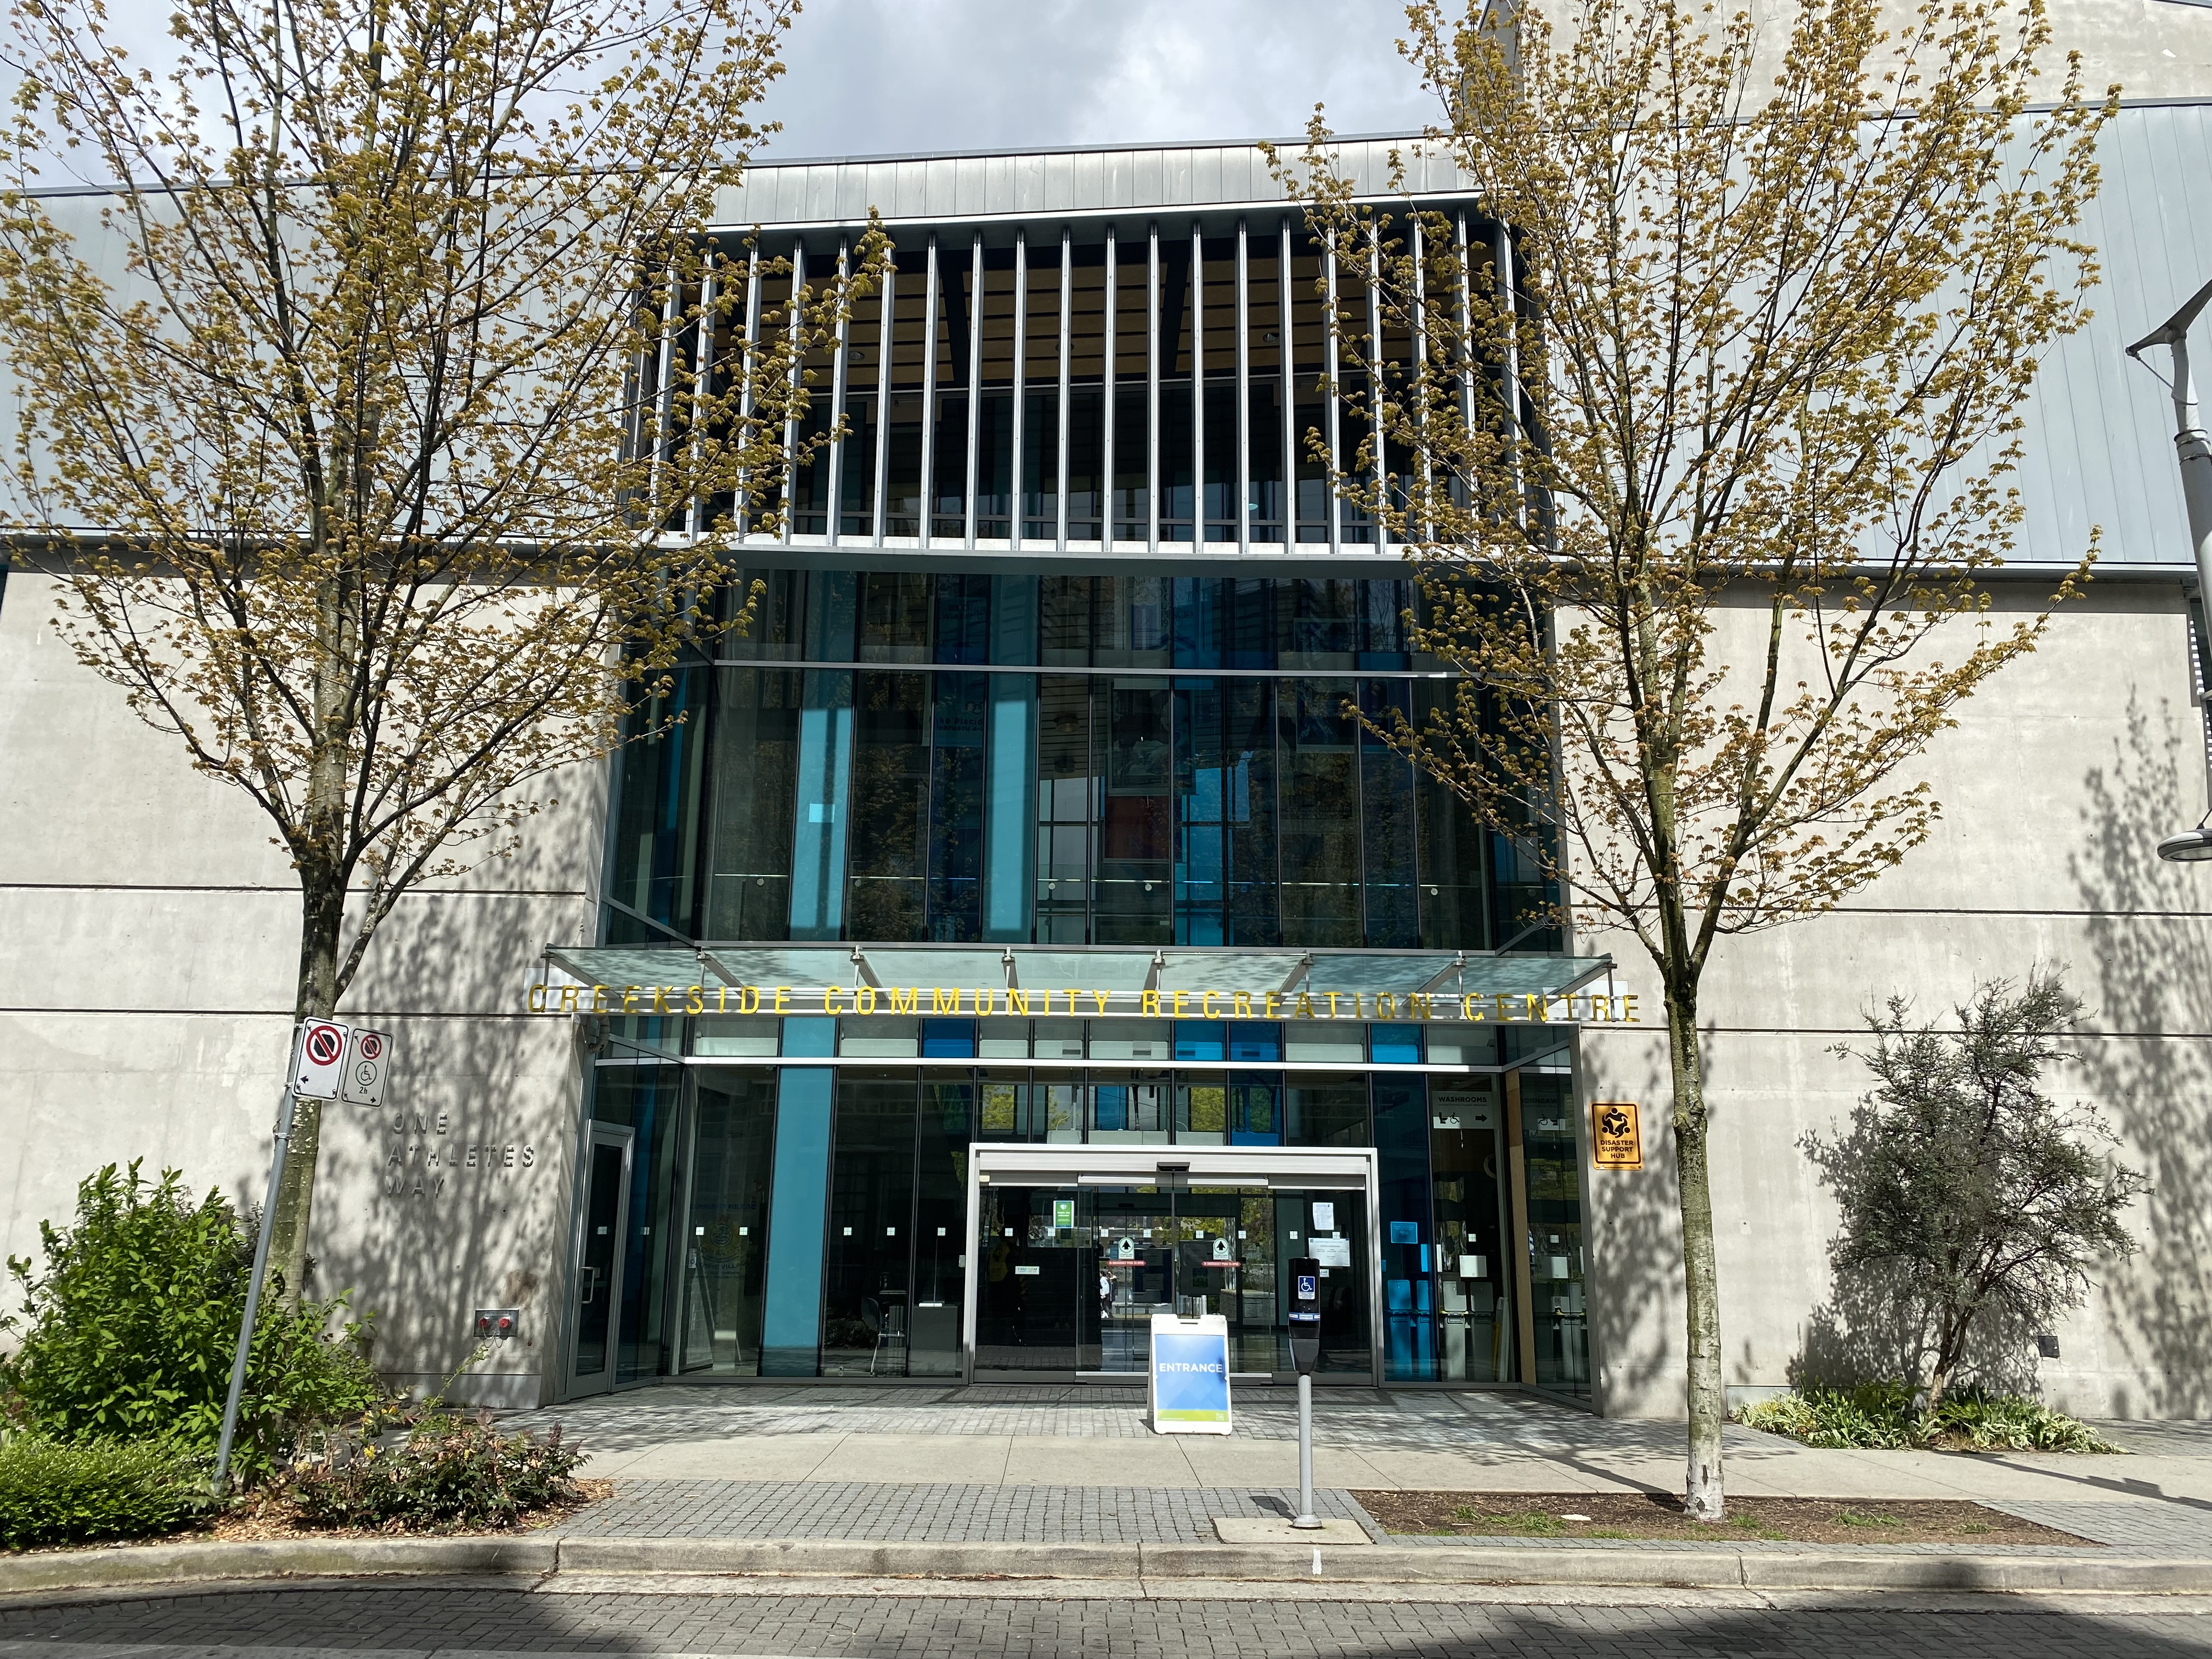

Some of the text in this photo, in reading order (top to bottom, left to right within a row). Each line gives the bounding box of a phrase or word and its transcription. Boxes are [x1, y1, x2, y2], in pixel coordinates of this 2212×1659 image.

[529, 984, 1640, 1022] CREEKSIDE COMMUNITY RECREATION CENTRE
[393, 1113, 448, 1135] ONE
[387, 1144, 534, 1167] ATHLETES
[386, 1176, 444, 1199] WAY
[1159, 1363, 1223, 1373] ENTRANCE
